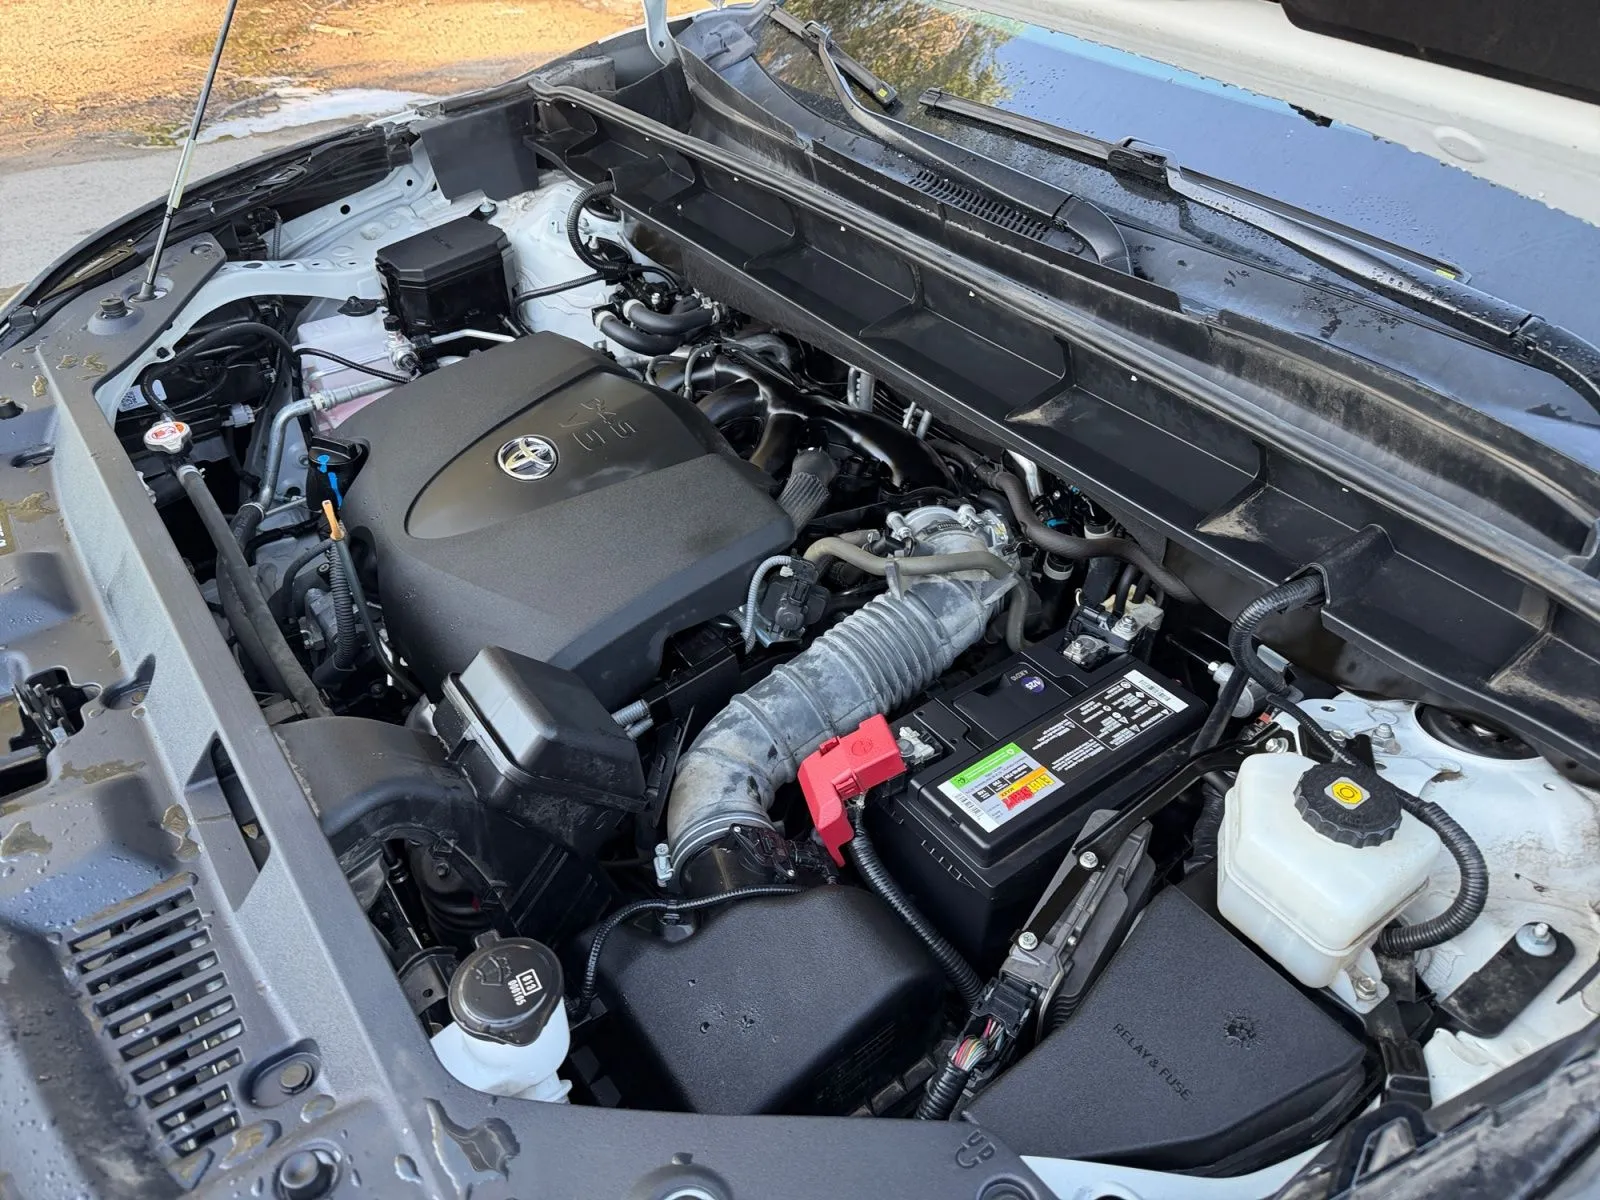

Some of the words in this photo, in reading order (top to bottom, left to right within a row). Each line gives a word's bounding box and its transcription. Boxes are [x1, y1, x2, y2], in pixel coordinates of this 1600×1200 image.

[1113, 1023, 1152, 1059] RELAY
[1148, 1059, 1160, 1069] &
[1159, 1068, 1192, 1101] FUSE
